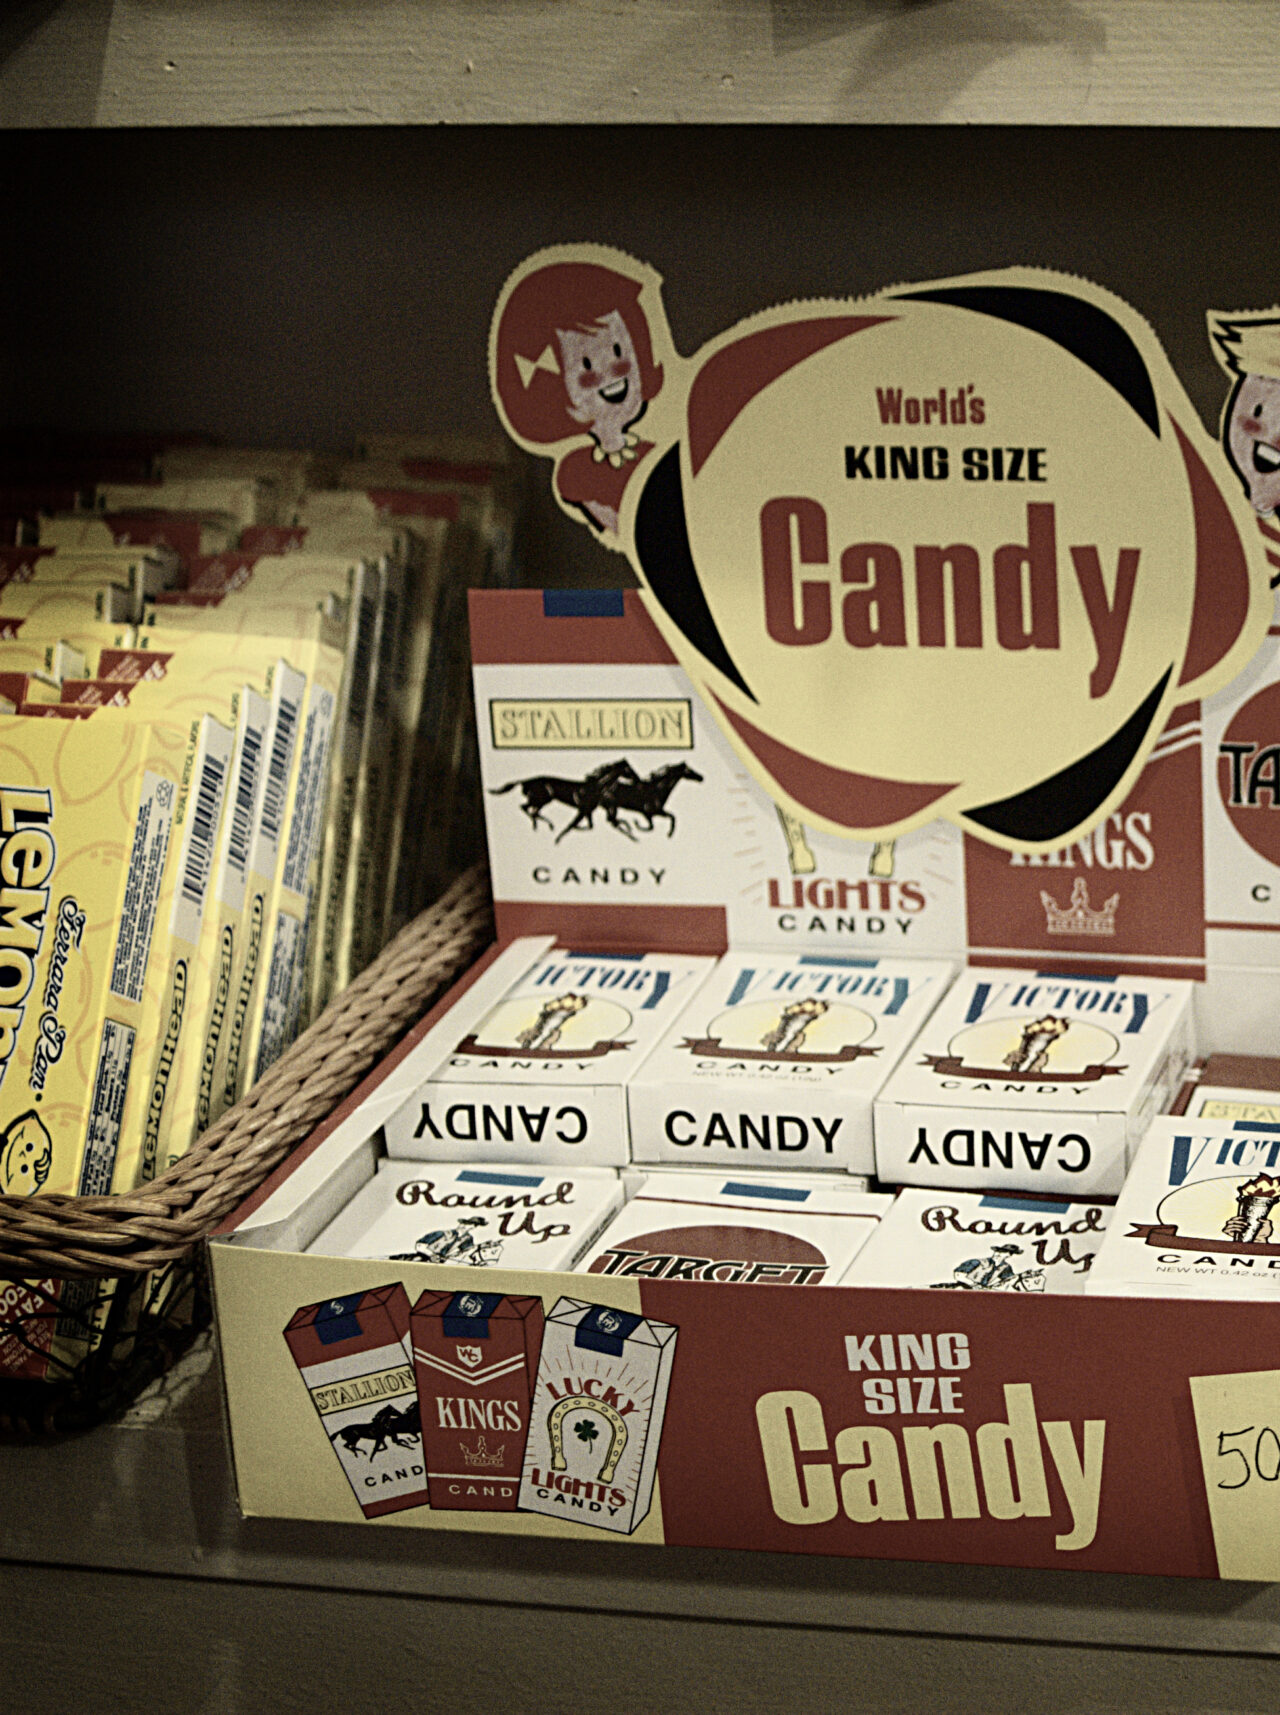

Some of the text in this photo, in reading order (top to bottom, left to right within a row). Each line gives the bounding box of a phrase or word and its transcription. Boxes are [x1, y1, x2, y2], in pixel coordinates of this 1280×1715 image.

[876, 382, 987, 426] World's
[844, 445, 1048, 482] KING SIZE
[759, 496, 1142, 699] Candy
[500, 709, 685, 740] STALLION
[532, 866, 667, 885] CANDY
[767, 878, 926, 914] LIGHTS
[778, 913, 914, 935] CANDY
[29, 895, 87, 1091] Ferrara Pan
[534, 963, 692, 1010] ICTORY
[725, 968, 930, 1016] VICTORY
[963, 983, 1171, 1034] VICTORY
[450, 1059, 593, 1071] CANDY
[697, 1061, 844, 1075] CANDY
[940, 1081, 1090, 1095] CANDY
[413, 1103, 588, 1145] CANDY
[665, 1110, 844, 1154] CANDY
[908, 1127, 1092, 1173] CANDY
[396, 1180, 575, 1209] Round
[498, 1211, 571, 1244] Up
[921, 1205, 1107, 1235] Round
[845, 1333, 971, 1371] KING
[315, 1369, 415, 1410] STALLION
[546, 1377, 641, 1416] LUCKY
[863, 1376, 965, 1414] SIZE
[437, 1397, 522, 1432] KINGS
[755, 1383, 1106, 1551] Candy
[531, 1468, 627, 1507] LIGHTS
[537, 1488, 619, 1517] CANDY
